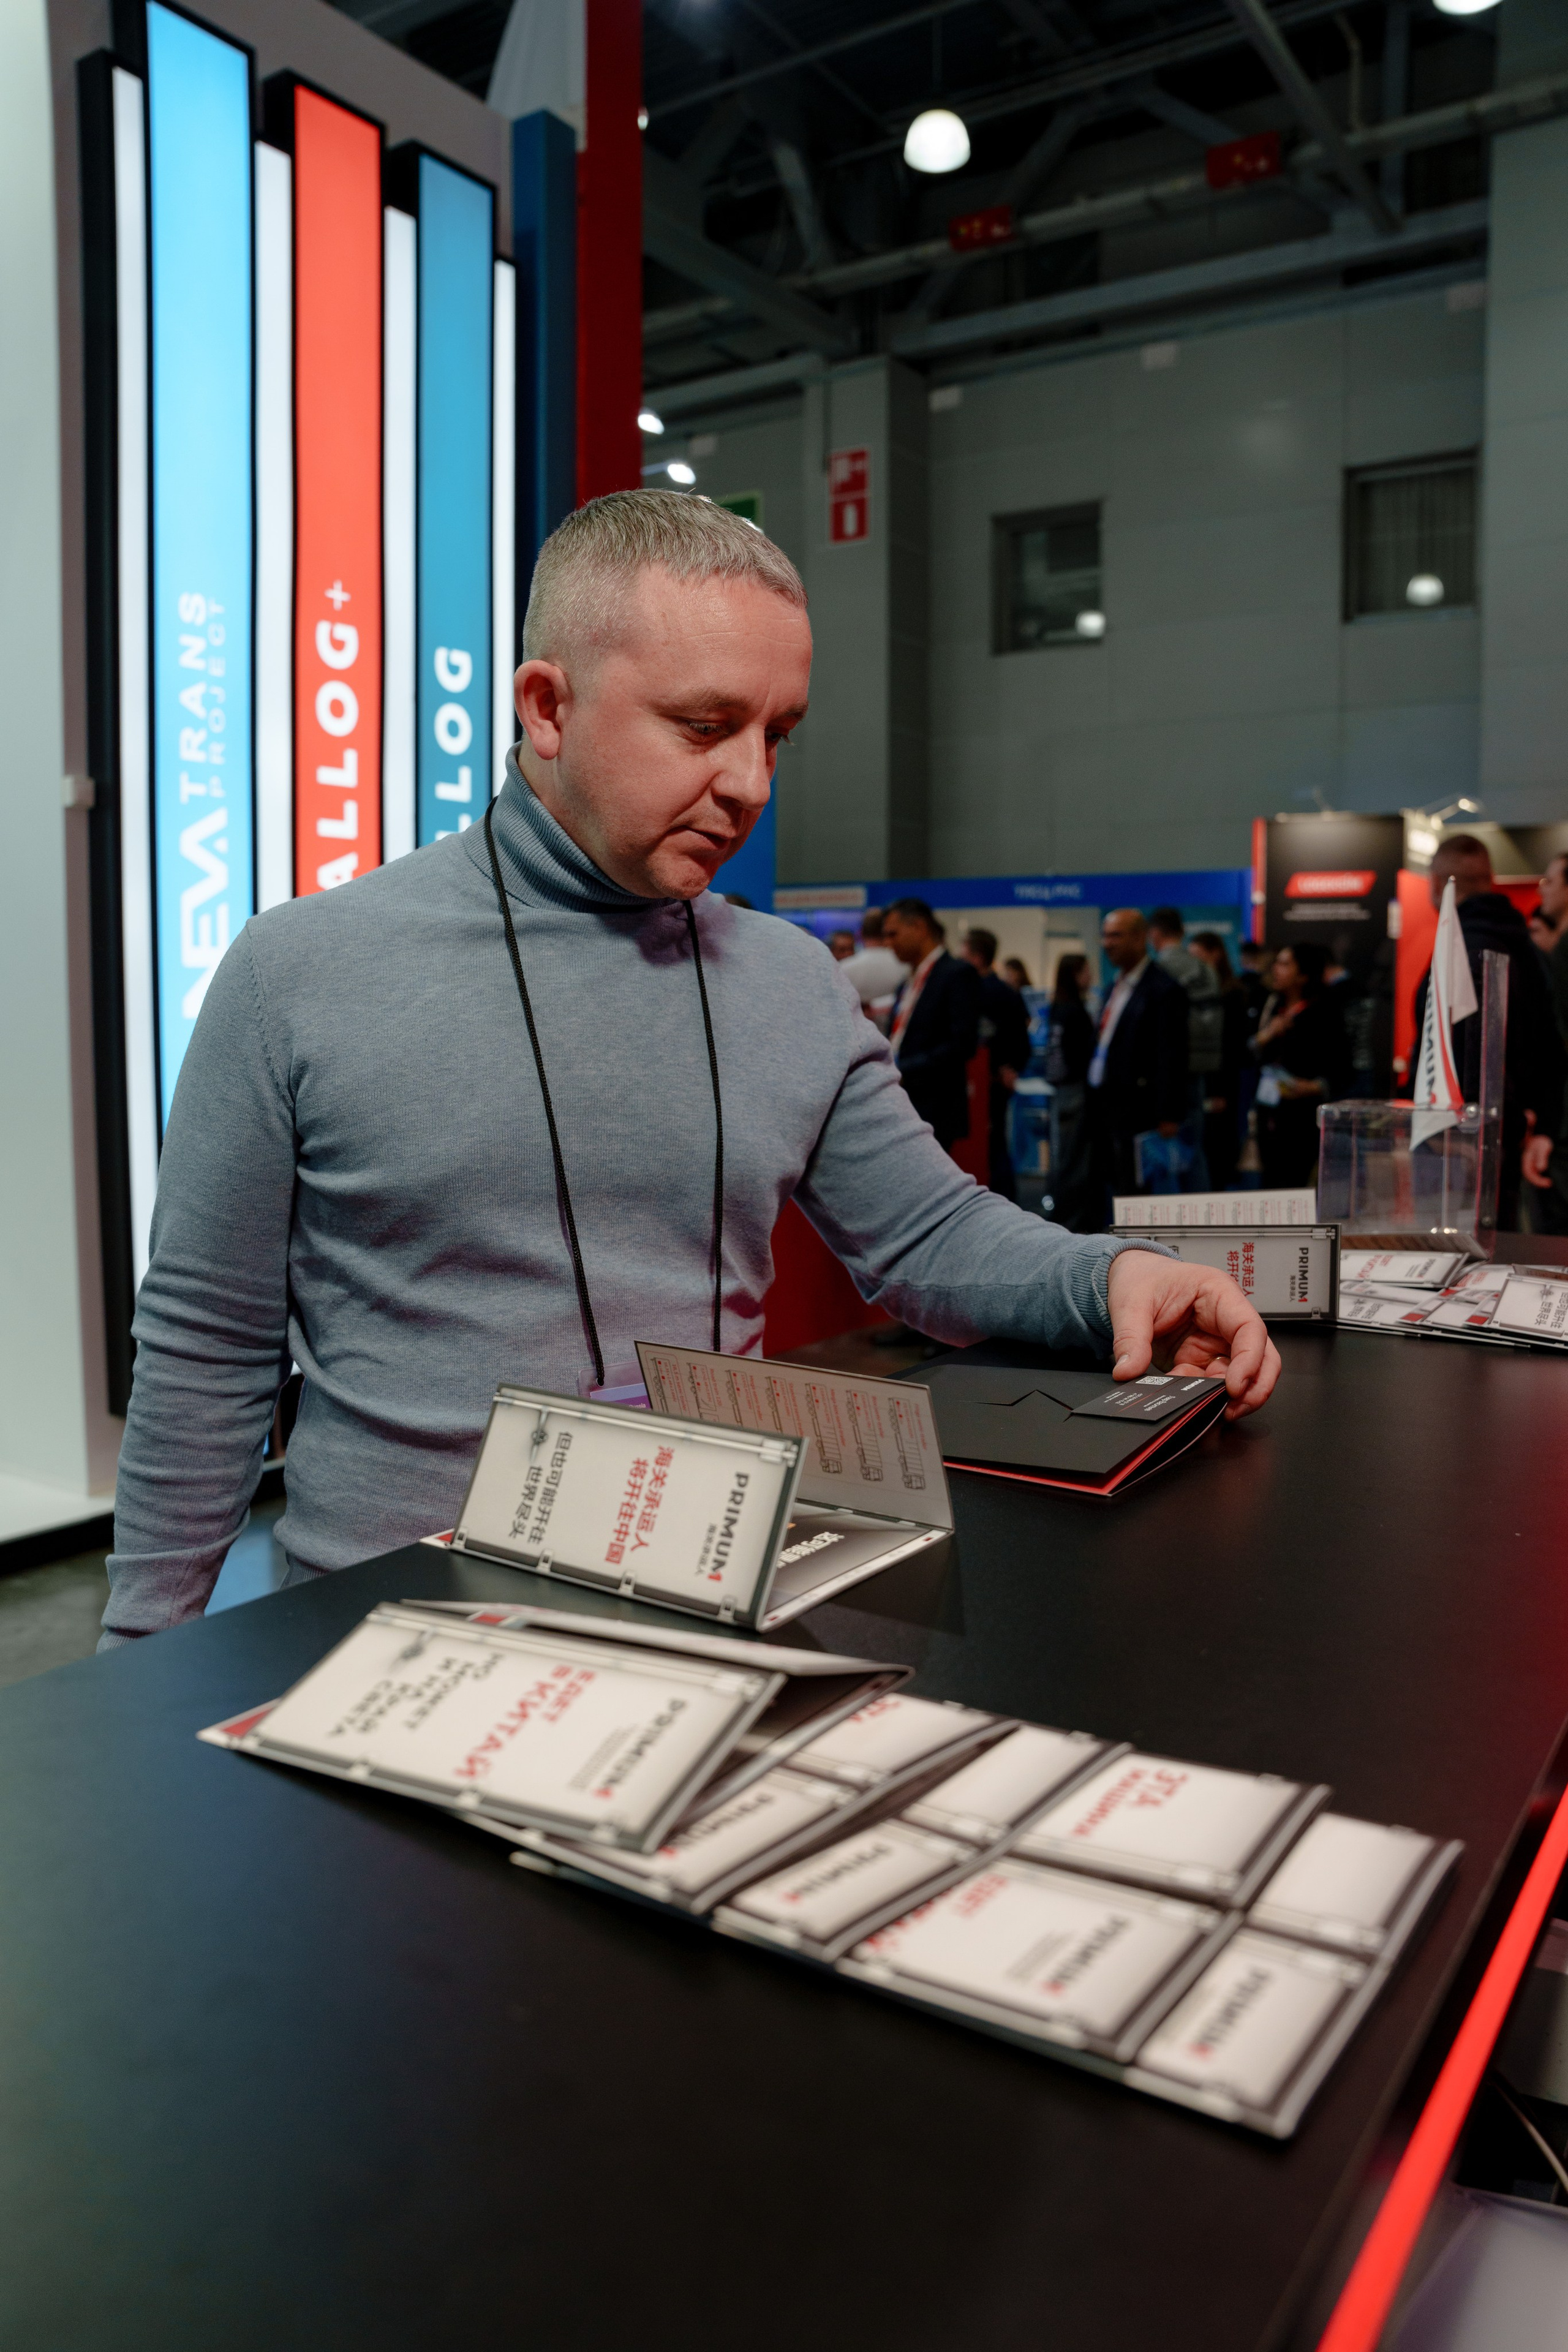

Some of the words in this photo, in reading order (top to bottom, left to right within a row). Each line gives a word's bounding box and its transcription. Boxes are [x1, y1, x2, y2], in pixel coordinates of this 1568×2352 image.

[179, 592, 208, 804] TRANS
[207, 598, 226, 797] PROJECT
[1242, 1242, 1254, 1297] 海关承运人
[508, 1464, 543, 1540] 世界尽头
[527, 1431, 574, 1545] 但也可能开往
[604, 1457, 649, 1566] 将开往中国
[629, 1444, 676, 1553] 海关承运人
[453, 1680, 557, 1778] КИТАЙ
